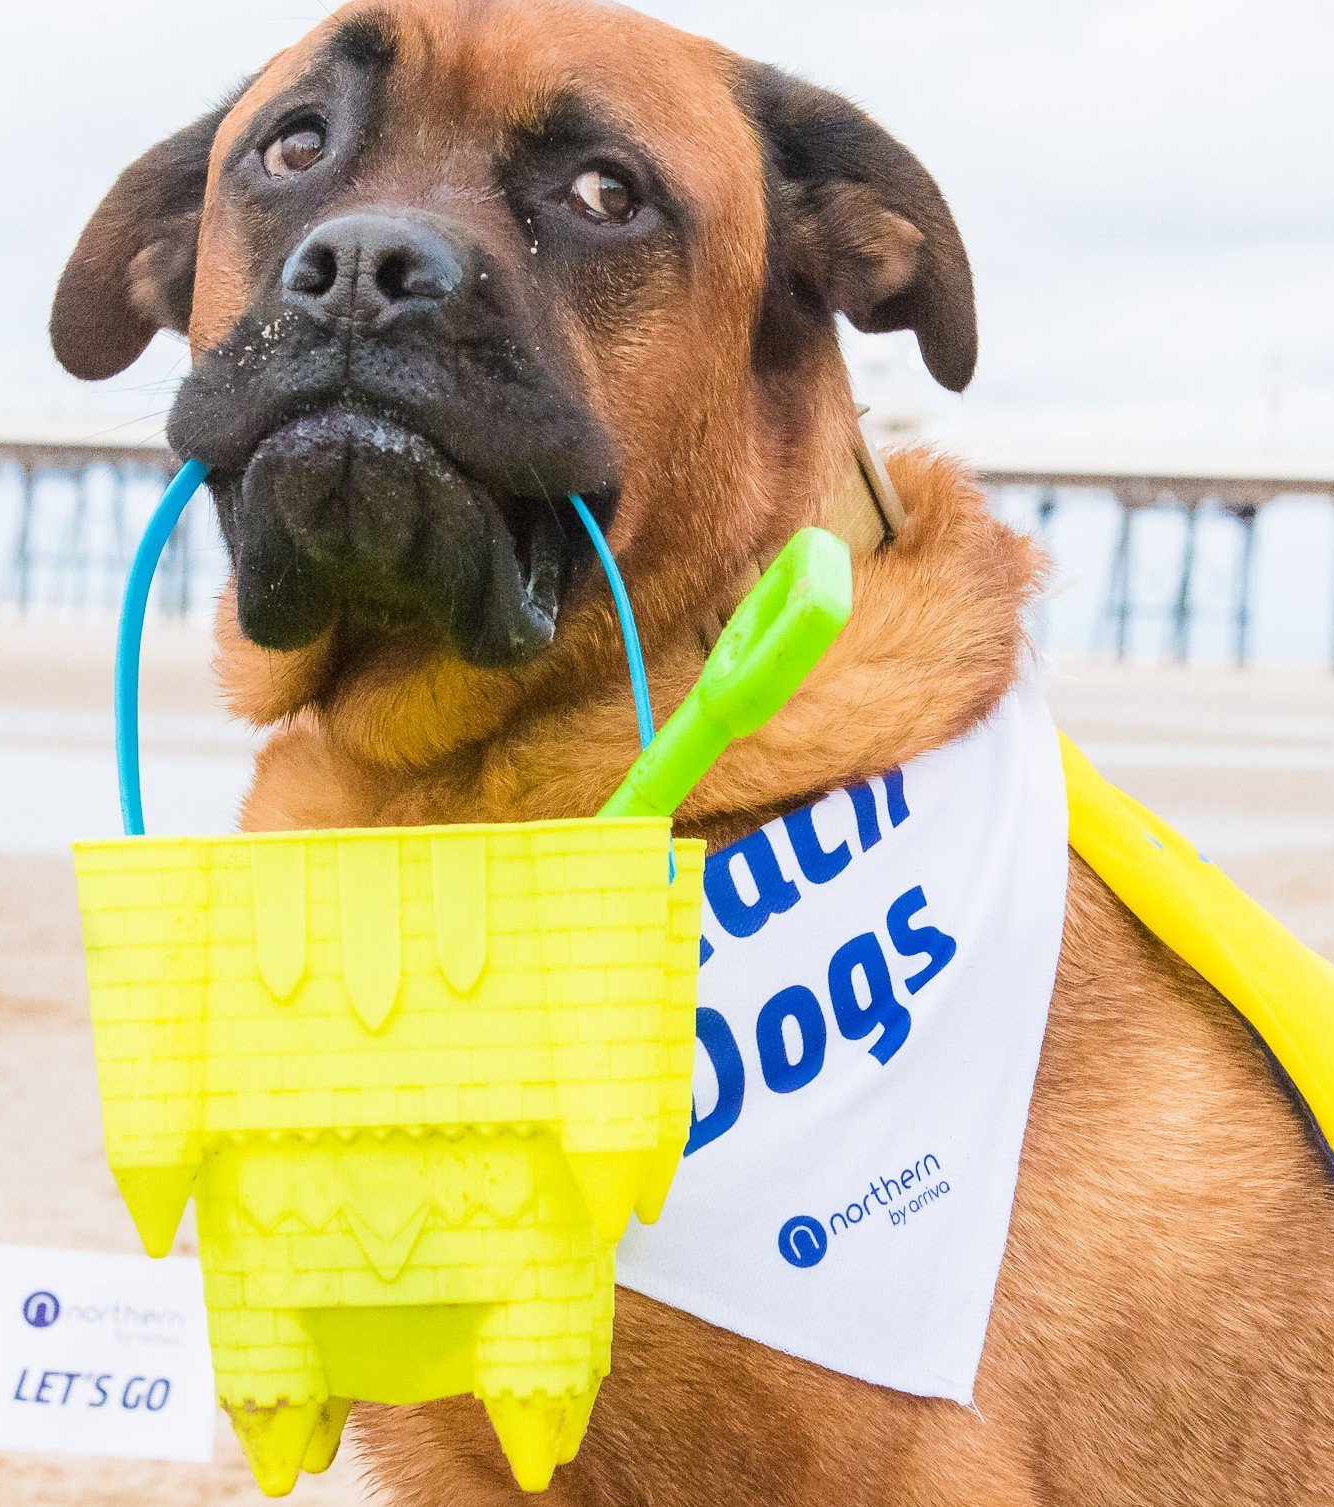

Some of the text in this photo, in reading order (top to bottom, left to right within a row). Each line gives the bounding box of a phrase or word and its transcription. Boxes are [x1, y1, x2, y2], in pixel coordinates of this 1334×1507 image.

[683, 884, 957, 1158] Dogs
[829, 1153, 942, 1235] northern
[888, 1180, 951, 1226] by arriva
[122, 1375, 171, 1411] GO
